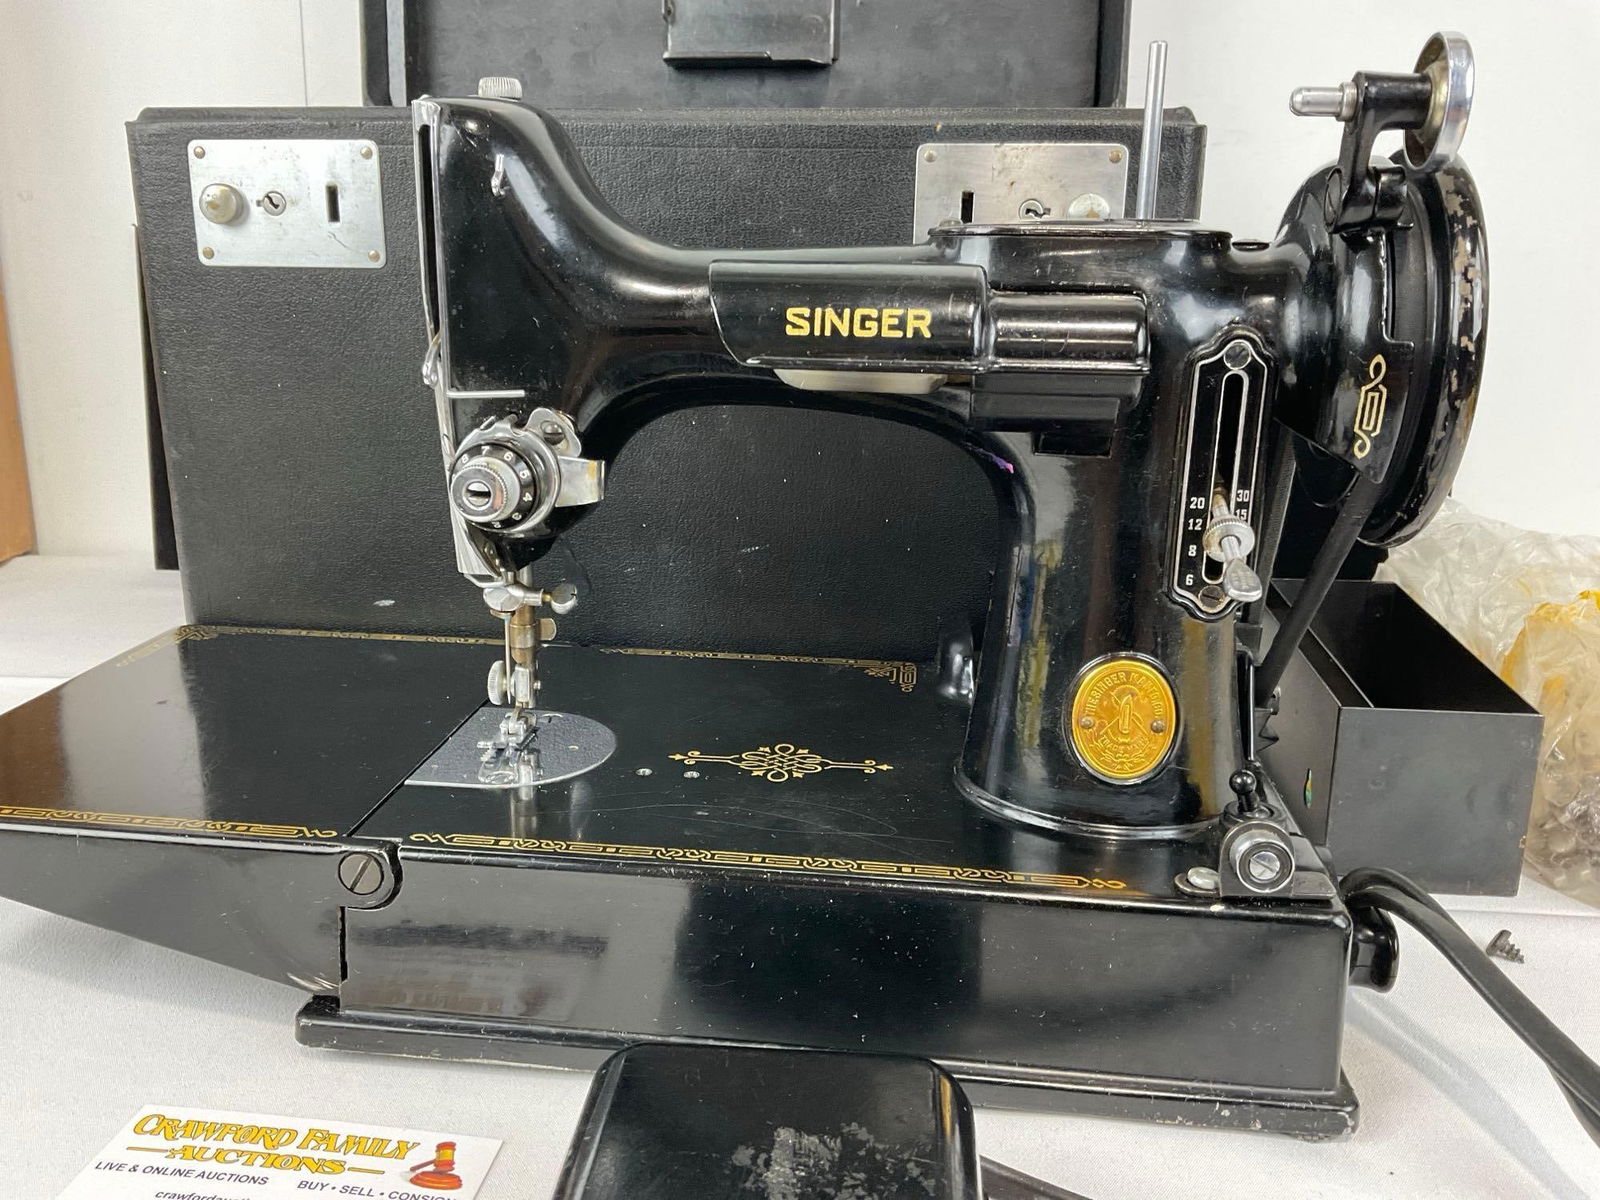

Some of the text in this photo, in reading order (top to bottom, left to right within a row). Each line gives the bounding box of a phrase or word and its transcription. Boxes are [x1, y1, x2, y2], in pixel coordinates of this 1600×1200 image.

[785, 307, 932, 338] SINGER
[481, 446, 490, 455] 7
[503, 451, 514, 461] 6
[519, 469, 530, 479] 5
[522, 492, 533, 502] 4
[1236, 490, 1250, 502] 30
[1189, 497, 1205, 509] 20
[1235, 509, 1248, 520] 15
[1188, 518, 1202, 530] 12
[1188, 545, 1197, 557] 8
[1185, 574, 1194, 586] 6
[133, 1113, 421, 1160] CRAWFORD FAMILY
[165, 1144, 347, 1175] AUCTIONS
[94, 1161, 270, 1186] LIVE & ONLINE AUCTIONS
[297, 1180, 330, 1192] BUY
[339, 1185, 376, 1198] SELL
